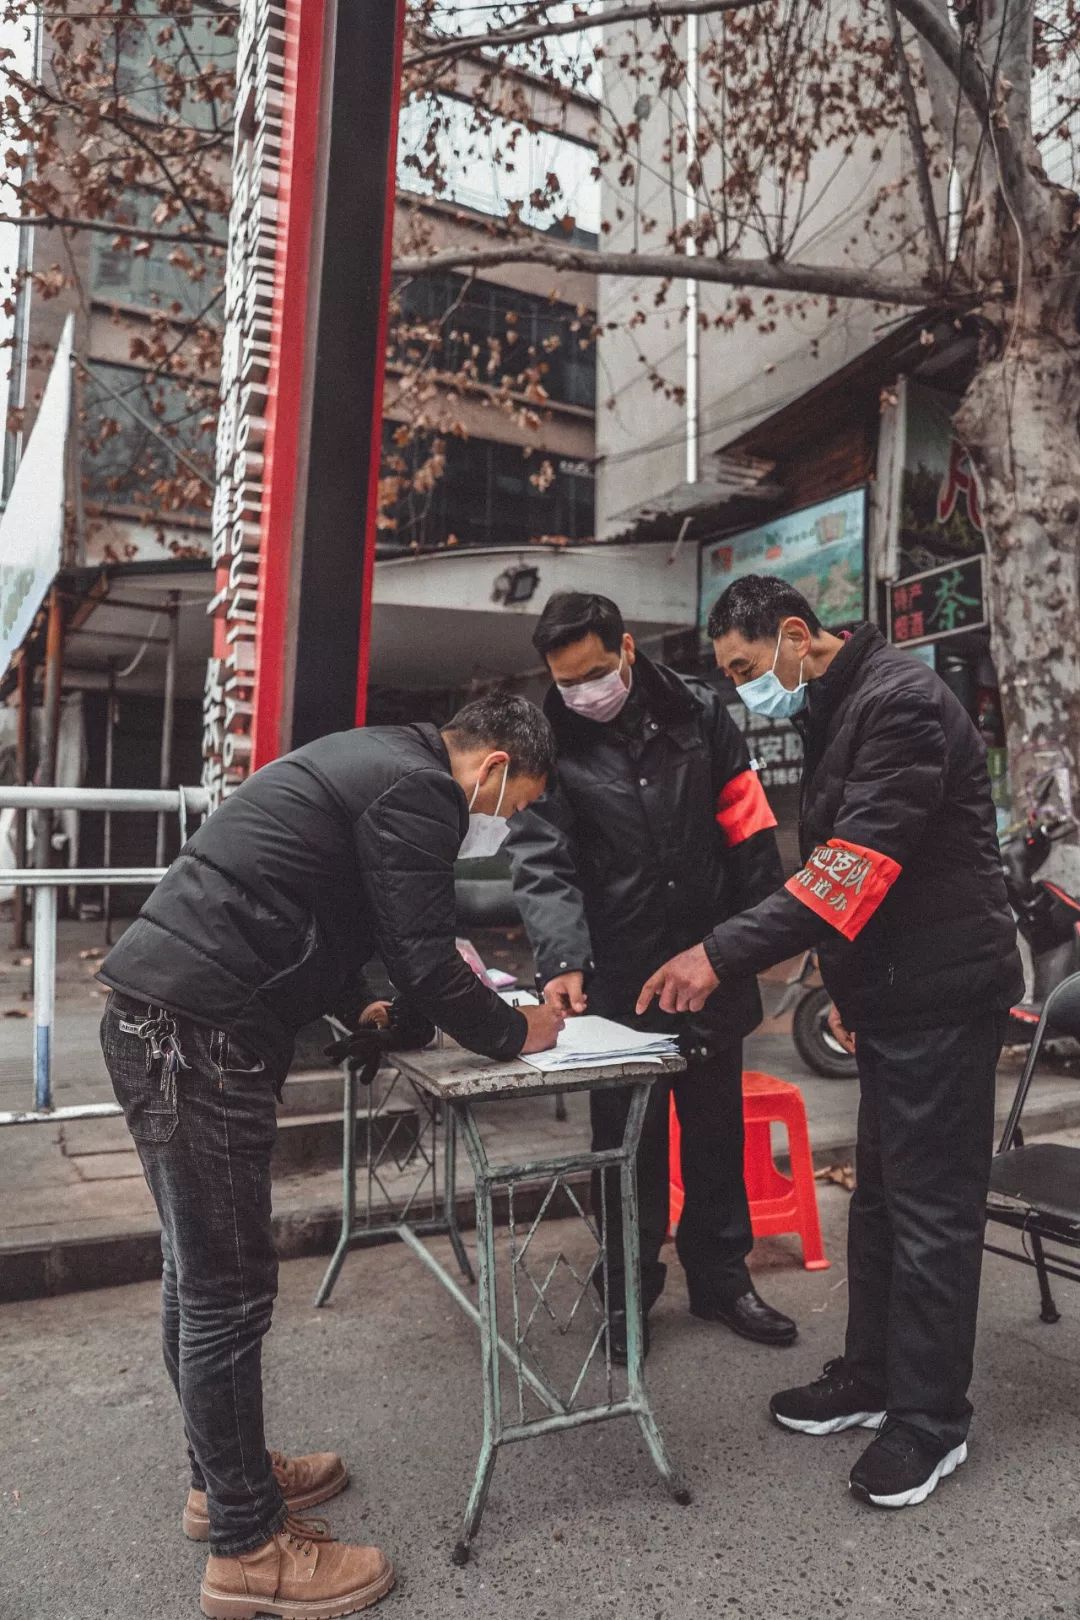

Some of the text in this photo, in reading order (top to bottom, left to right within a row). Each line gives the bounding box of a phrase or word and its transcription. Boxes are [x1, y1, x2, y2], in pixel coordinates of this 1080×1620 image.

[926, 567, 981, 631] 茶
[809, 847, 871, 895] 巡逻队
